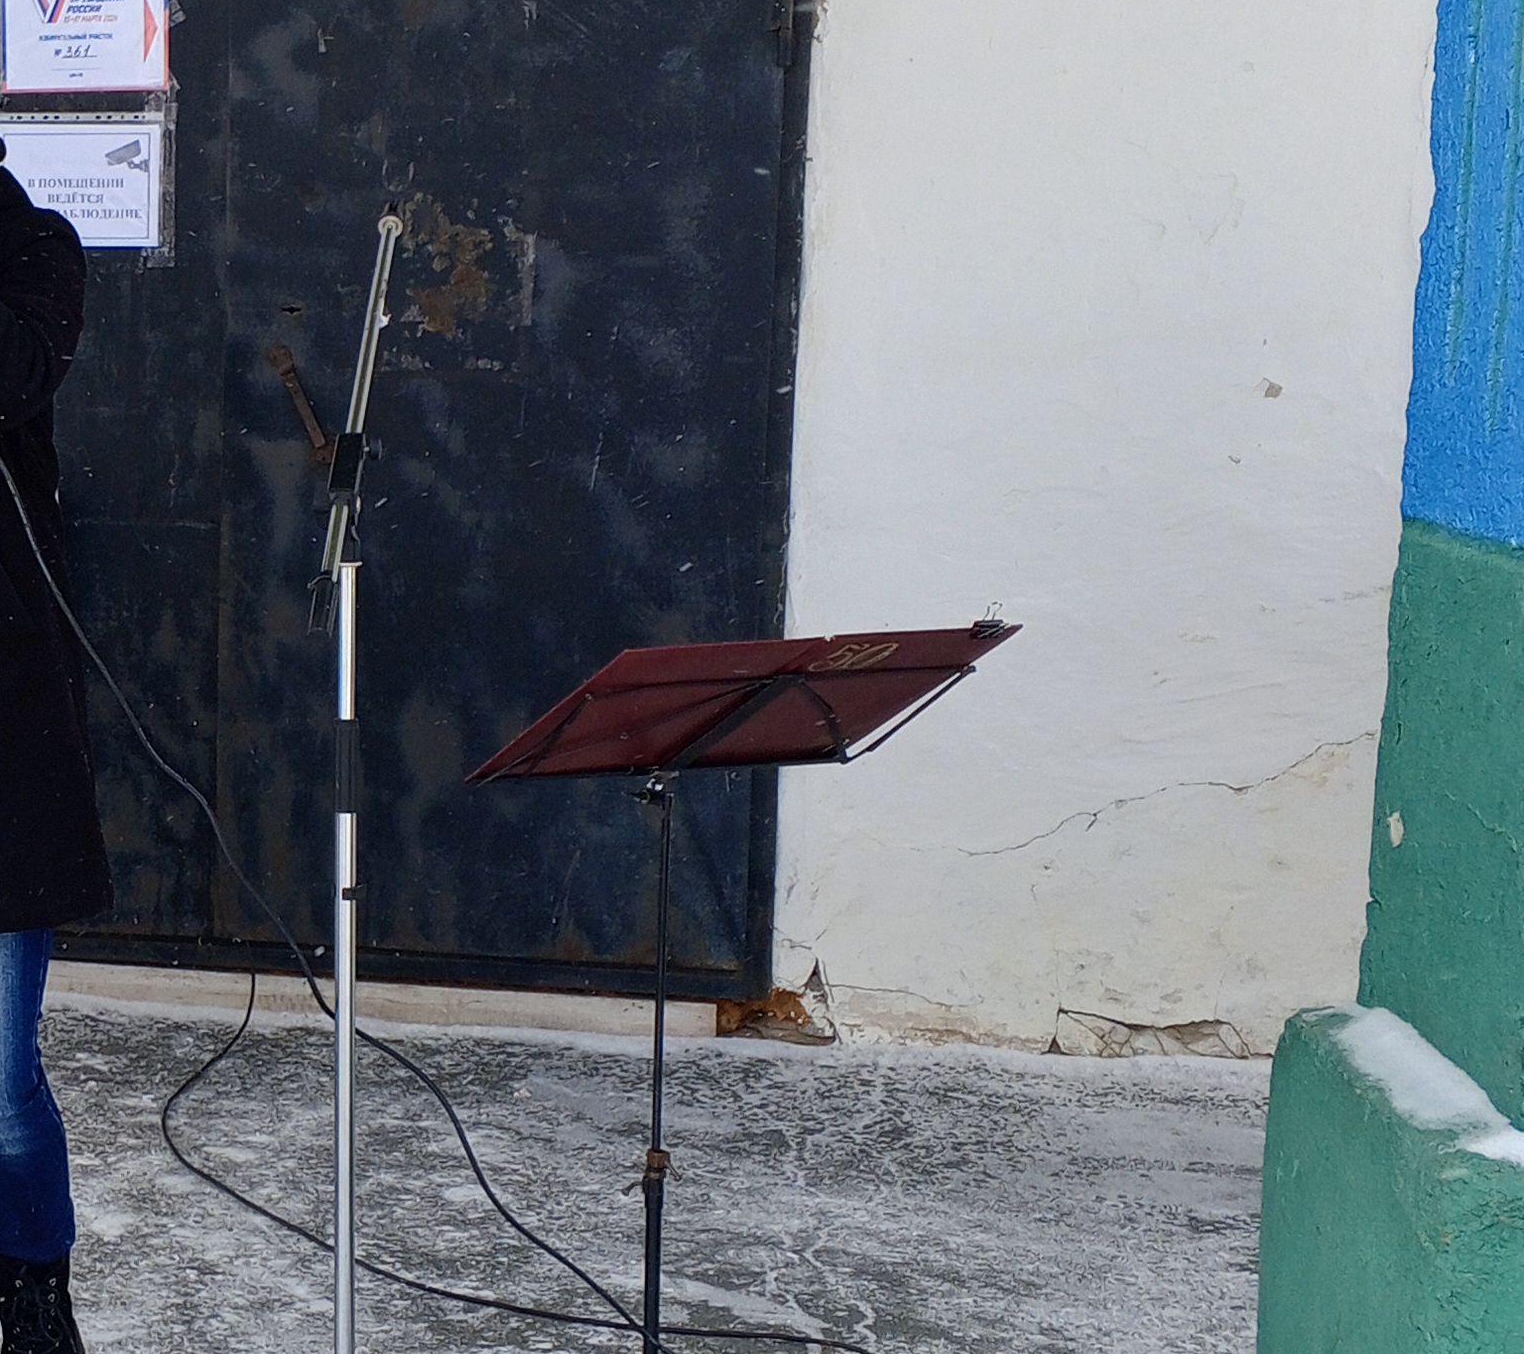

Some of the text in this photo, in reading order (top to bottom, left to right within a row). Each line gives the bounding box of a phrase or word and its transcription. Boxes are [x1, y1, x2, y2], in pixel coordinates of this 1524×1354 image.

[66, 4, 103, 15] РОССИИ
[66, 44, 92, 58] 361
[27, 178, 125, 190] В ПОМЕЩЕНИИ
[47, 191, 105, 204] ВЕДЁТСЯ
